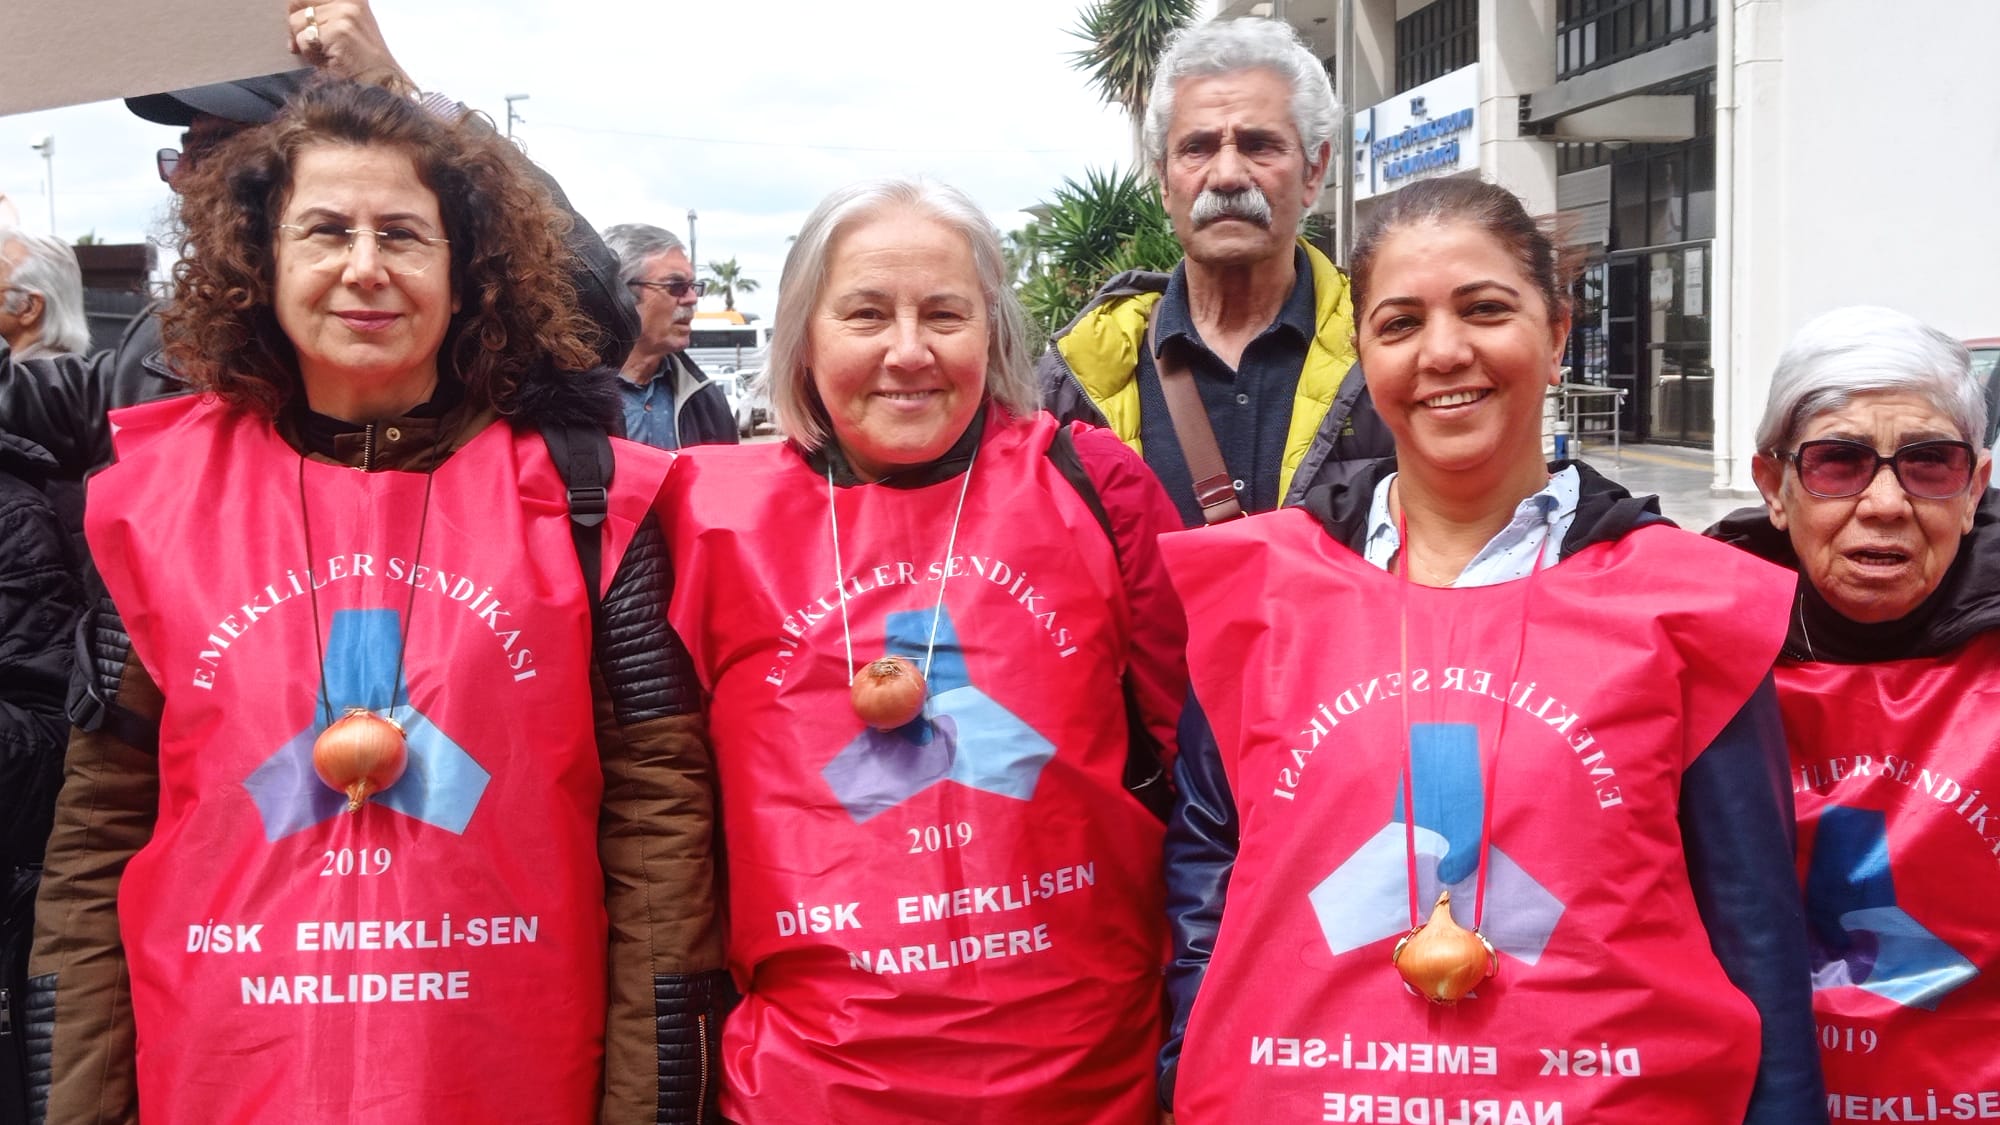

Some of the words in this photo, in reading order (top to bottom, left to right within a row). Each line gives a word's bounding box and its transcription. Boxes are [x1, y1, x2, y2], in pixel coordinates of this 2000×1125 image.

[193, 553, 375, 690] EMEKLİLER
[386, 557, 537, 682] SENDİKASI
[928, 555, 1078, 658] SENDİKASI
[909, 823, 973, 854] 2019
[320, 848, 392, 877] 2019
[776, 902, 863, 937] DİSK
[899, 861, 1095, 925] EMEKLİ-SEN
[186, 918, 263, 954] DİSK
[296, 913, 538, 952] EMEKLİ-SEN
[849, 924, 1052, 975] NARLIDERE
[241, 972, 470, 1005] NARLIDERE
[1815, 1024, 1878, 1054] 019
